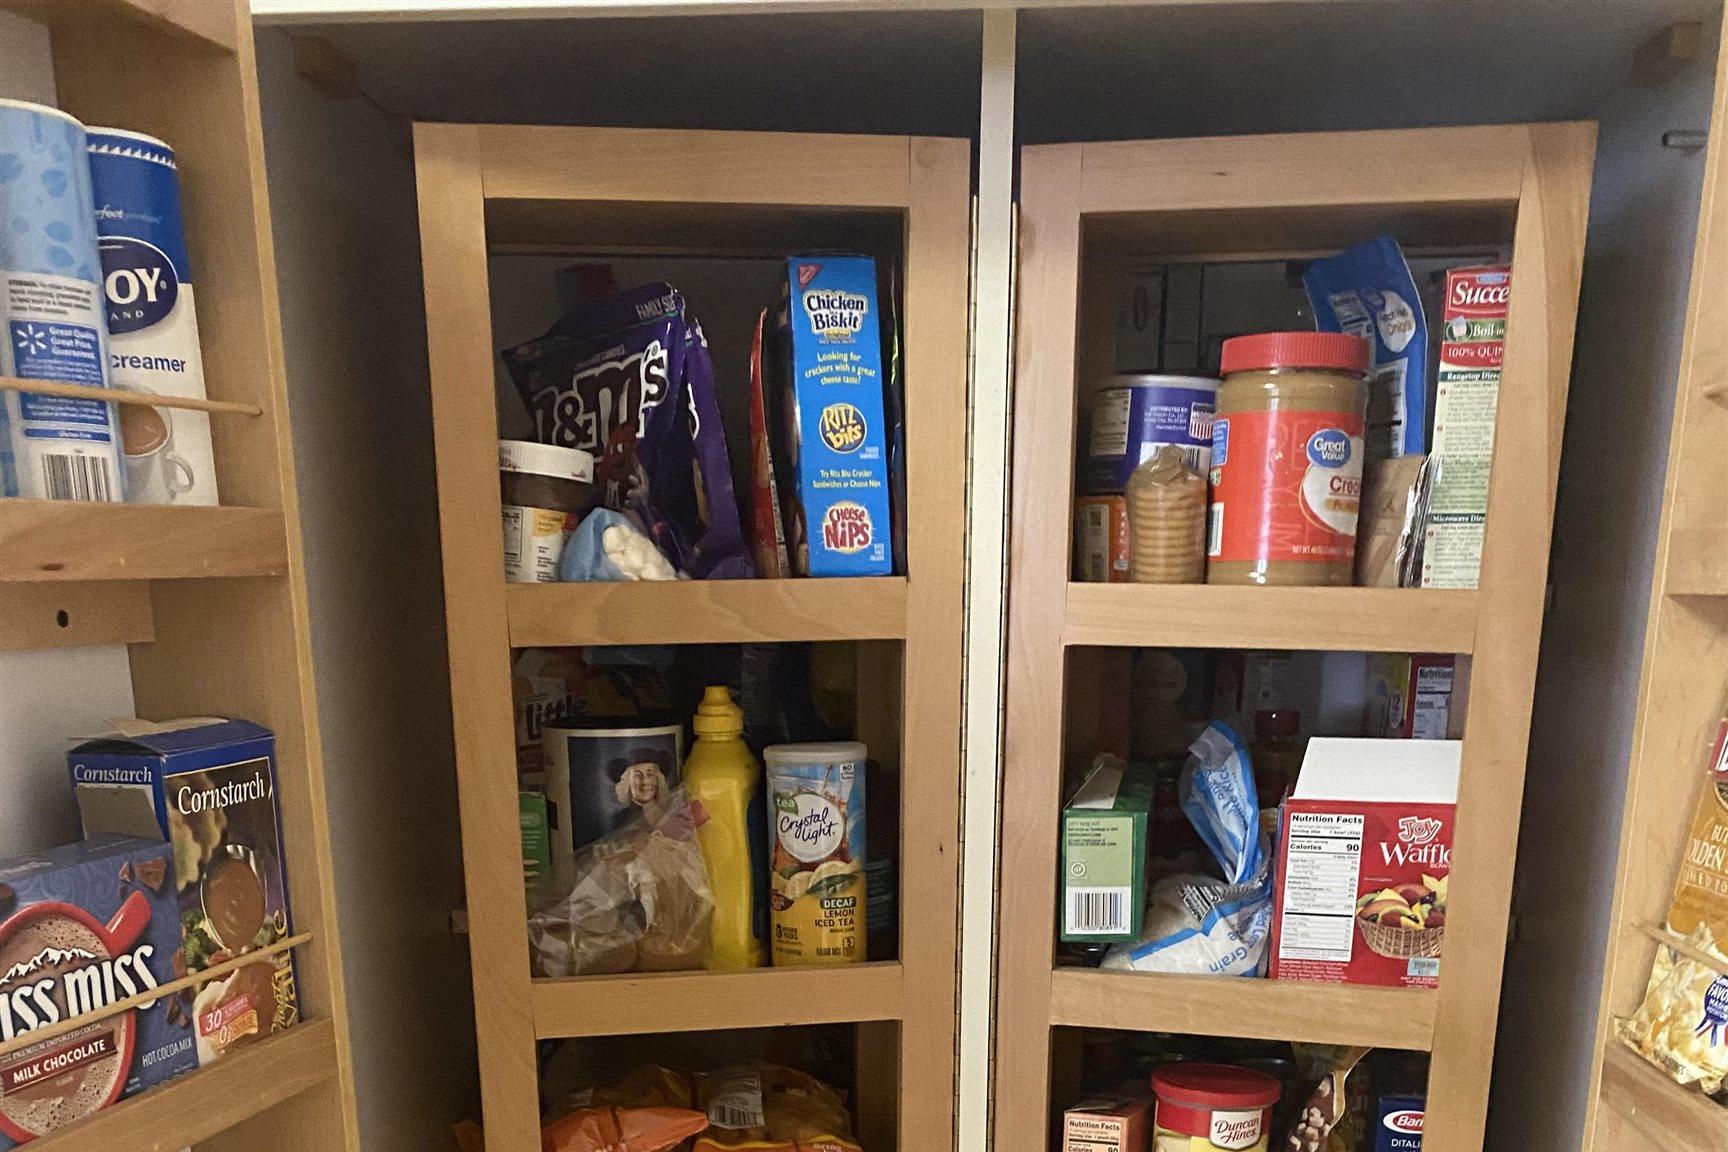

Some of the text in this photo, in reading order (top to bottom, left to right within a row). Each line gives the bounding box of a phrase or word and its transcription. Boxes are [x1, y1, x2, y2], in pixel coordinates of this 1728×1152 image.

[1452, 279, 1509, 306] Succe
[635, 299, 662, 320] FAMILY
[807, 293, 865, 313] Chicken
[813, 312, 859, 331] Biskit
[817, 351, 861, 362] Looking for
[1448, 346, 1475, 358] 100%
[805, 364, 834, 377] crackers
[835, 362, 850, 373] with
[857, 367, 876, 377] great
[821, 374, 861, 385] cheese taste!
[823, 405, 858, 431] RITZ
[1314, 437, 1345, 452] Great
[1321, 450, 1345, 461] Value
[820, 469, 872, 479] Try Ritz Bits Cracker
[813, 480, 843, 488] Sandwiches
[850, 480, 867, 488] Cheese
[1433, 514, 1470, 523] Microwave
[74, 764, 152, 783] Cornstarch
[842, 764, 853, 772] NO
[178, 771, 265, 815] Cornstarch
[775, 798, 795, 808] tea
[780, 806, 829, 839] Crystal
[1292, 814, 1363, 824] Nutrition Facts
[1345, 843, 1360, 852] 90
[823, 898, 854, 908] DECAF
[824, 908, 855, 918] LEMON
[815, 917, 855, 927] ICED TEA
[1209, 946, 1248, 973] Grain
[63, 944, 158, 1018] MISS
[205, 1008, 222, 1032] 30
[142, 1038, 193, 1068] HOT COCOA MIX
[13, 1038, 106, 1084] MILK CHOCOLATE
[1069, 1119, 1121, 1131] Nutrition Facts
[1214, 1117, 1260, 1134] Duncan
[1220, 1127, 1257, 1144] Hines
